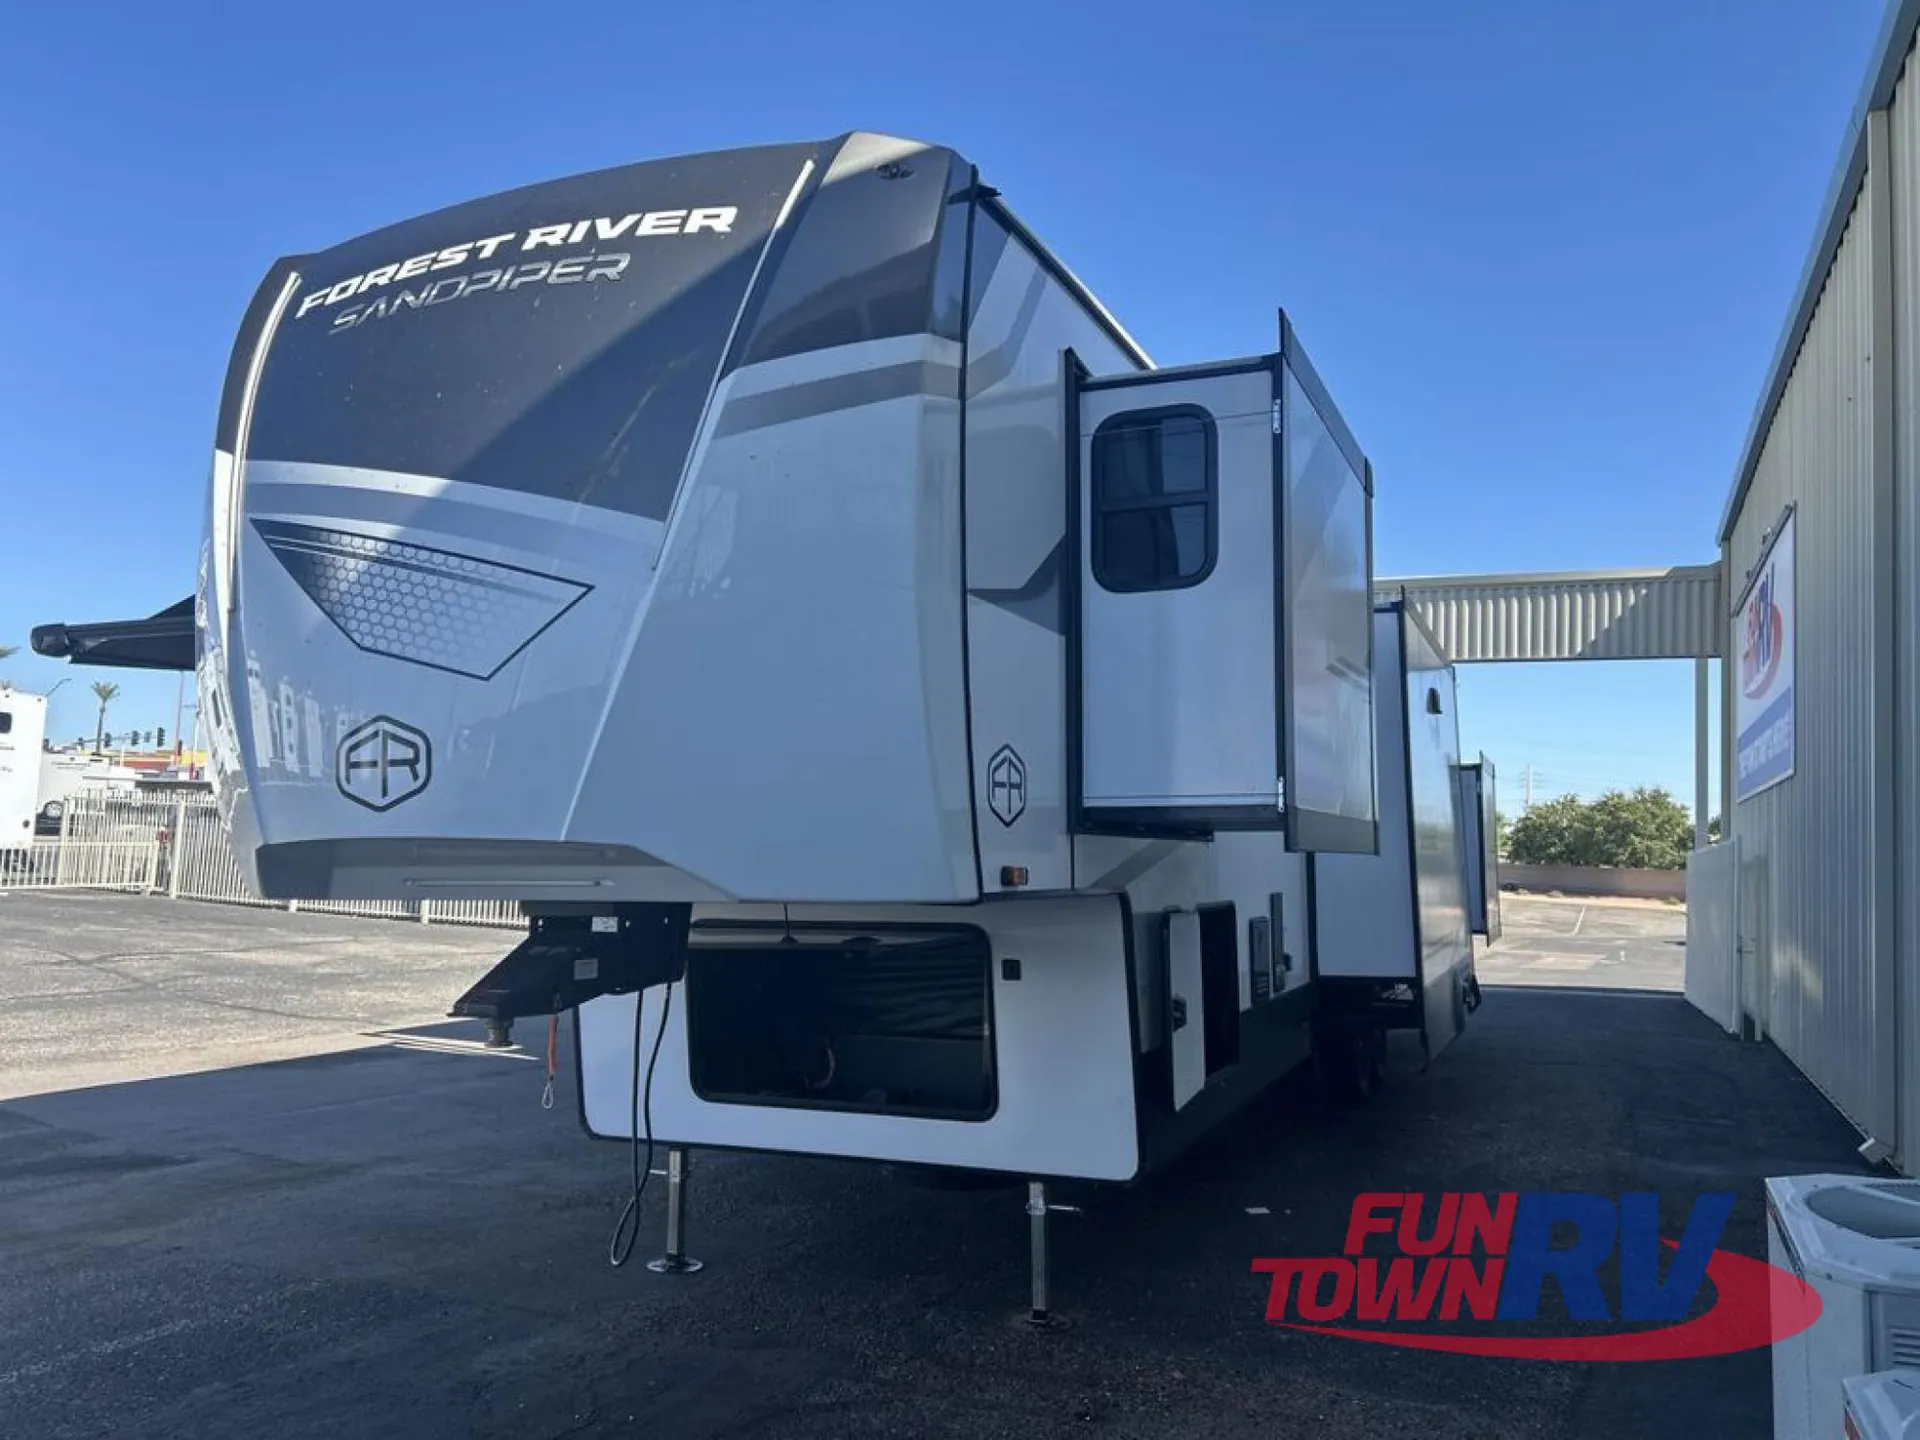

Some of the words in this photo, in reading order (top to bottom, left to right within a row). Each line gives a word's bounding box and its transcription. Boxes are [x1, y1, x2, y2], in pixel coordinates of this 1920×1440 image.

[295, 233, 514, 318] FOREST
[521, 206, 738, 251] RIVER
[328, 253, 631, 334] SANDPIPER
